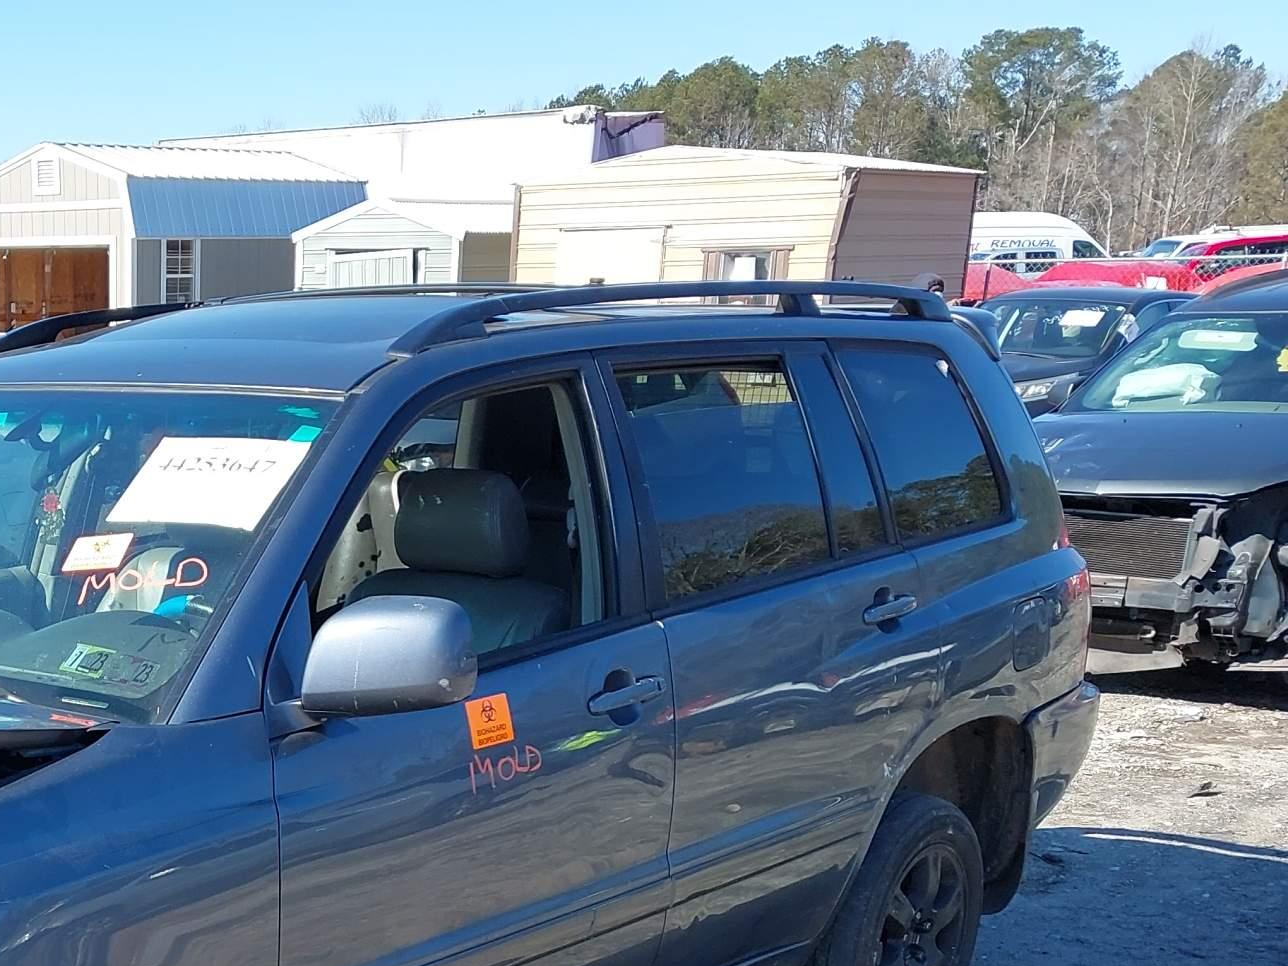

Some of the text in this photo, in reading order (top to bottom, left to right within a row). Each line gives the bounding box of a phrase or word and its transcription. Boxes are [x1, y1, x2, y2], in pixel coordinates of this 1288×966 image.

[990, 239, 1057, 248] REMOVAL
[77, 557, 208, 605] MOLD
[131, 662, 155, 683] 23
[469, 745, 542, 795] MOLD
